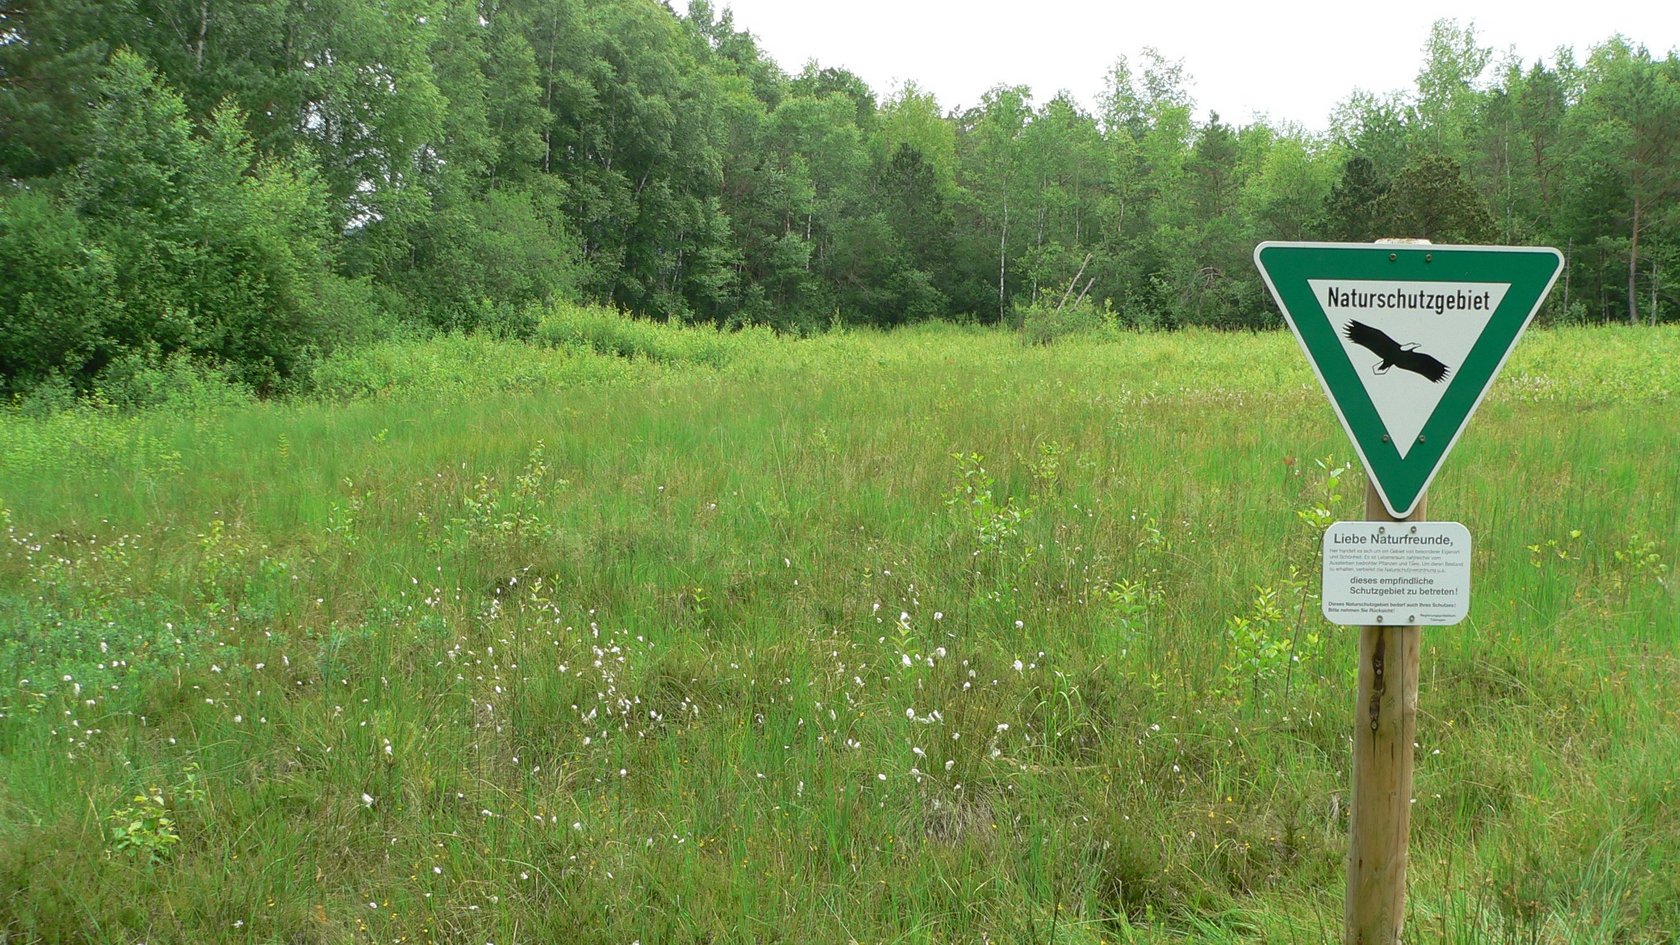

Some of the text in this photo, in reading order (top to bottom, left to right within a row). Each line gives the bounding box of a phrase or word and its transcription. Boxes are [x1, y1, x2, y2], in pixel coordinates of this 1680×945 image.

[1328, 287, 1490, 315] Naturschutzgebiet
[1334, 533, 1453, 547] Liebe Naturfreunde,
[1380, 577, 1434, 586] empfindliche
[1350, 586, 1405, 596] Schutzgebiet
